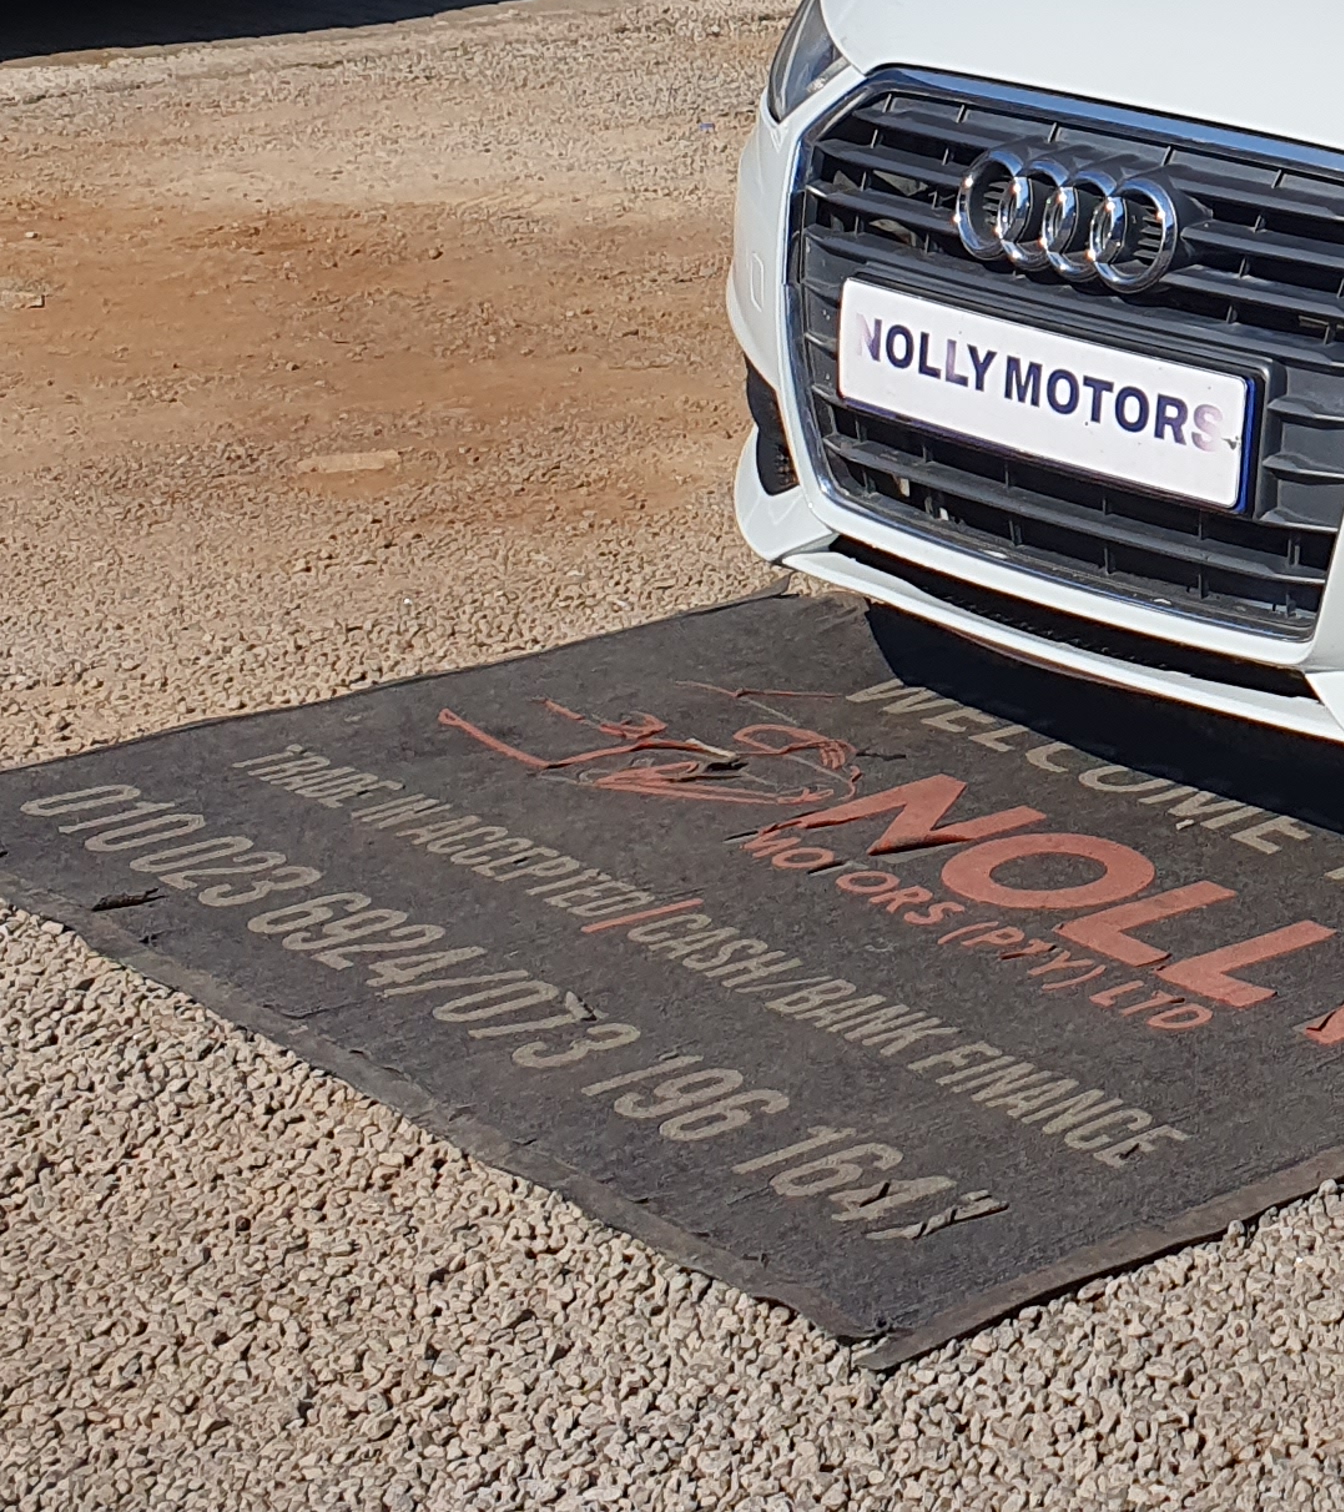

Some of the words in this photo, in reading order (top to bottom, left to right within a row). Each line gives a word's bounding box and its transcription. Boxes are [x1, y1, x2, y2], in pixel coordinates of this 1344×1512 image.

[855, 312, 998, 393] NOLLY
[1003, 354, 1224, 454] MOTORS
[845, 678, 1311, 856] WELCOME
[231, 744, 406, 809] TRADE
[350, 793, 453, 830] IN
[908, 1039, 1190, 1170] FINANCE
[1089, 980, 1214, 1030] LTD
[580, 1052, 790, 1142] 196
